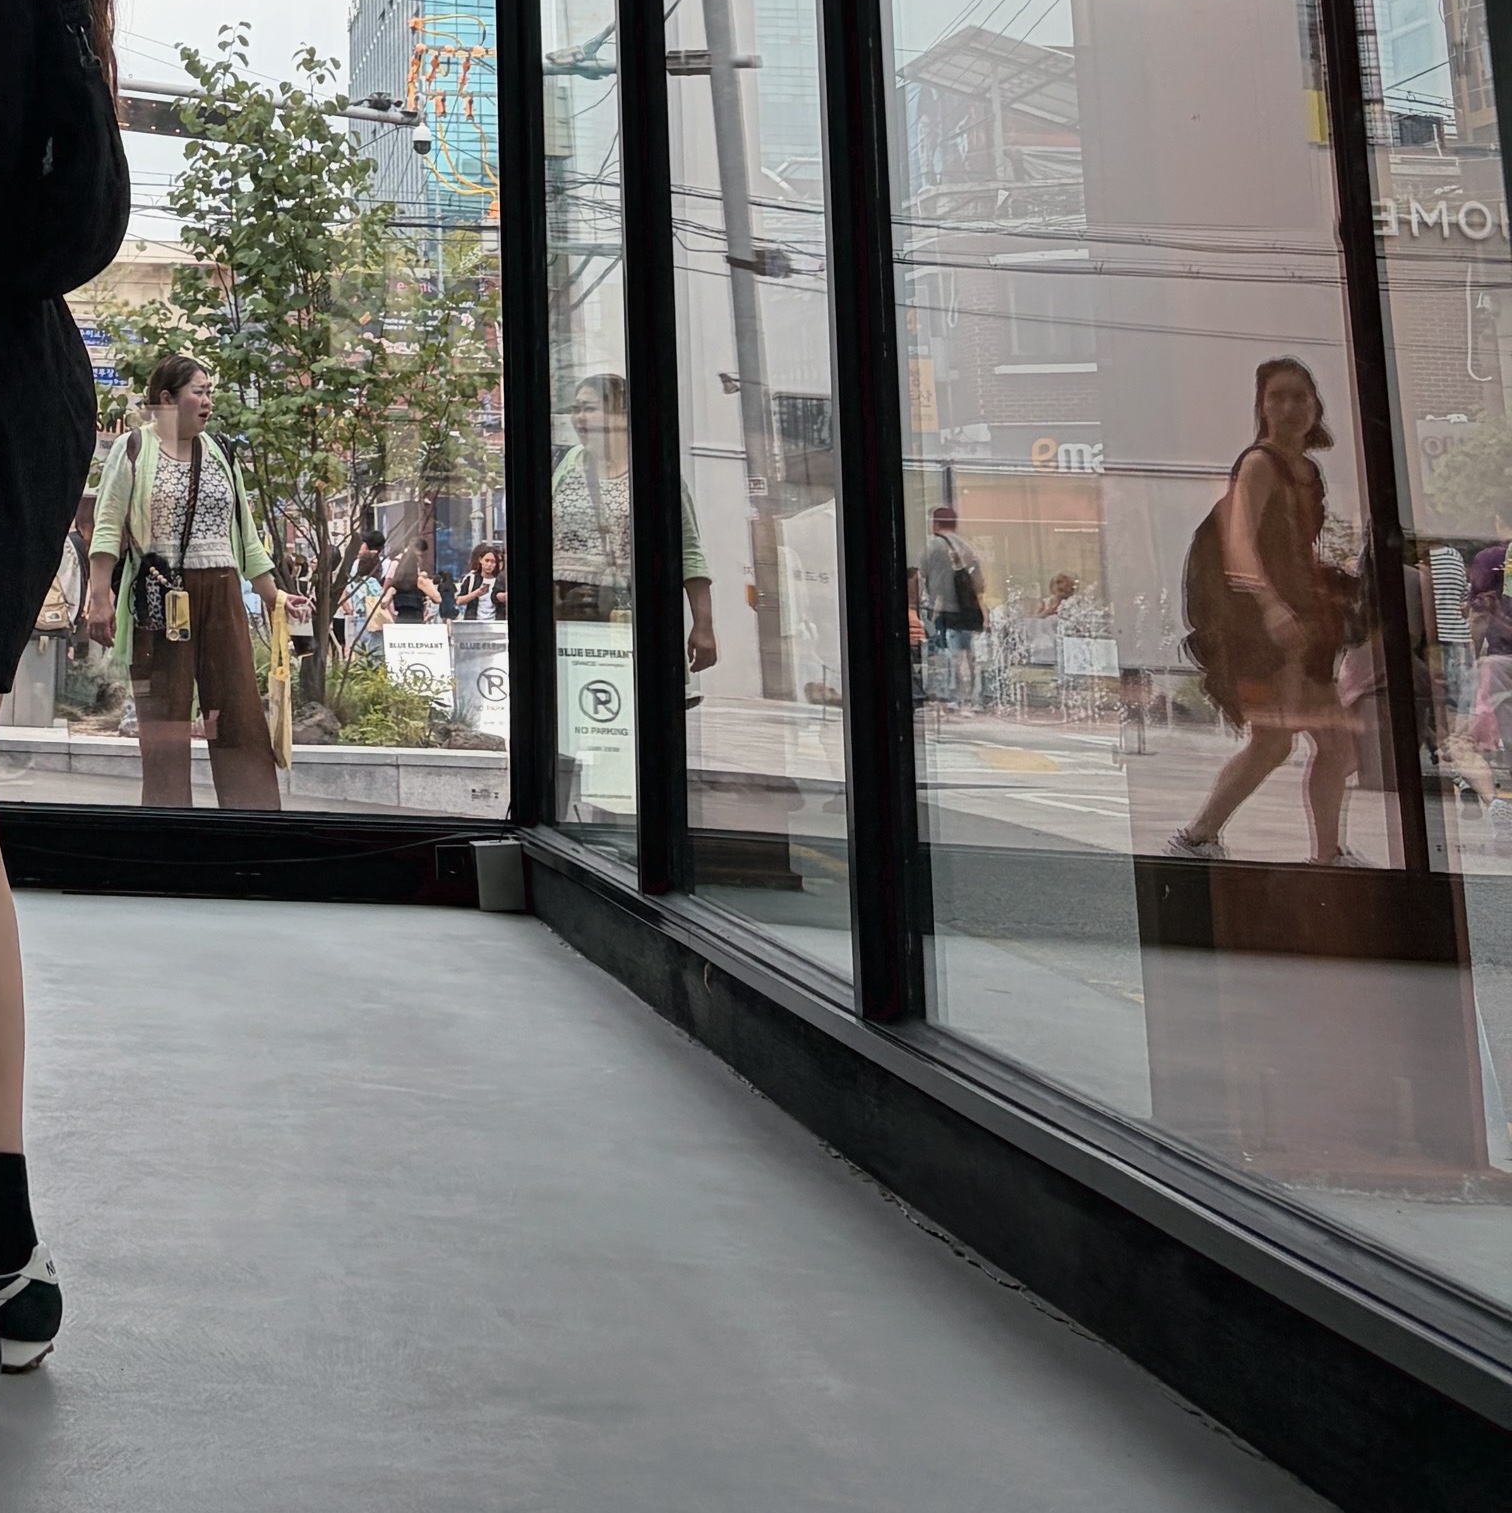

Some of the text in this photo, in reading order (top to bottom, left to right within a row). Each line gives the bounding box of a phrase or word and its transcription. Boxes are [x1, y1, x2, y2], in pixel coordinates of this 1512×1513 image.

[557, 647, 584, 658] BLUE
[574, 726, 629, 737] NO PARKING
